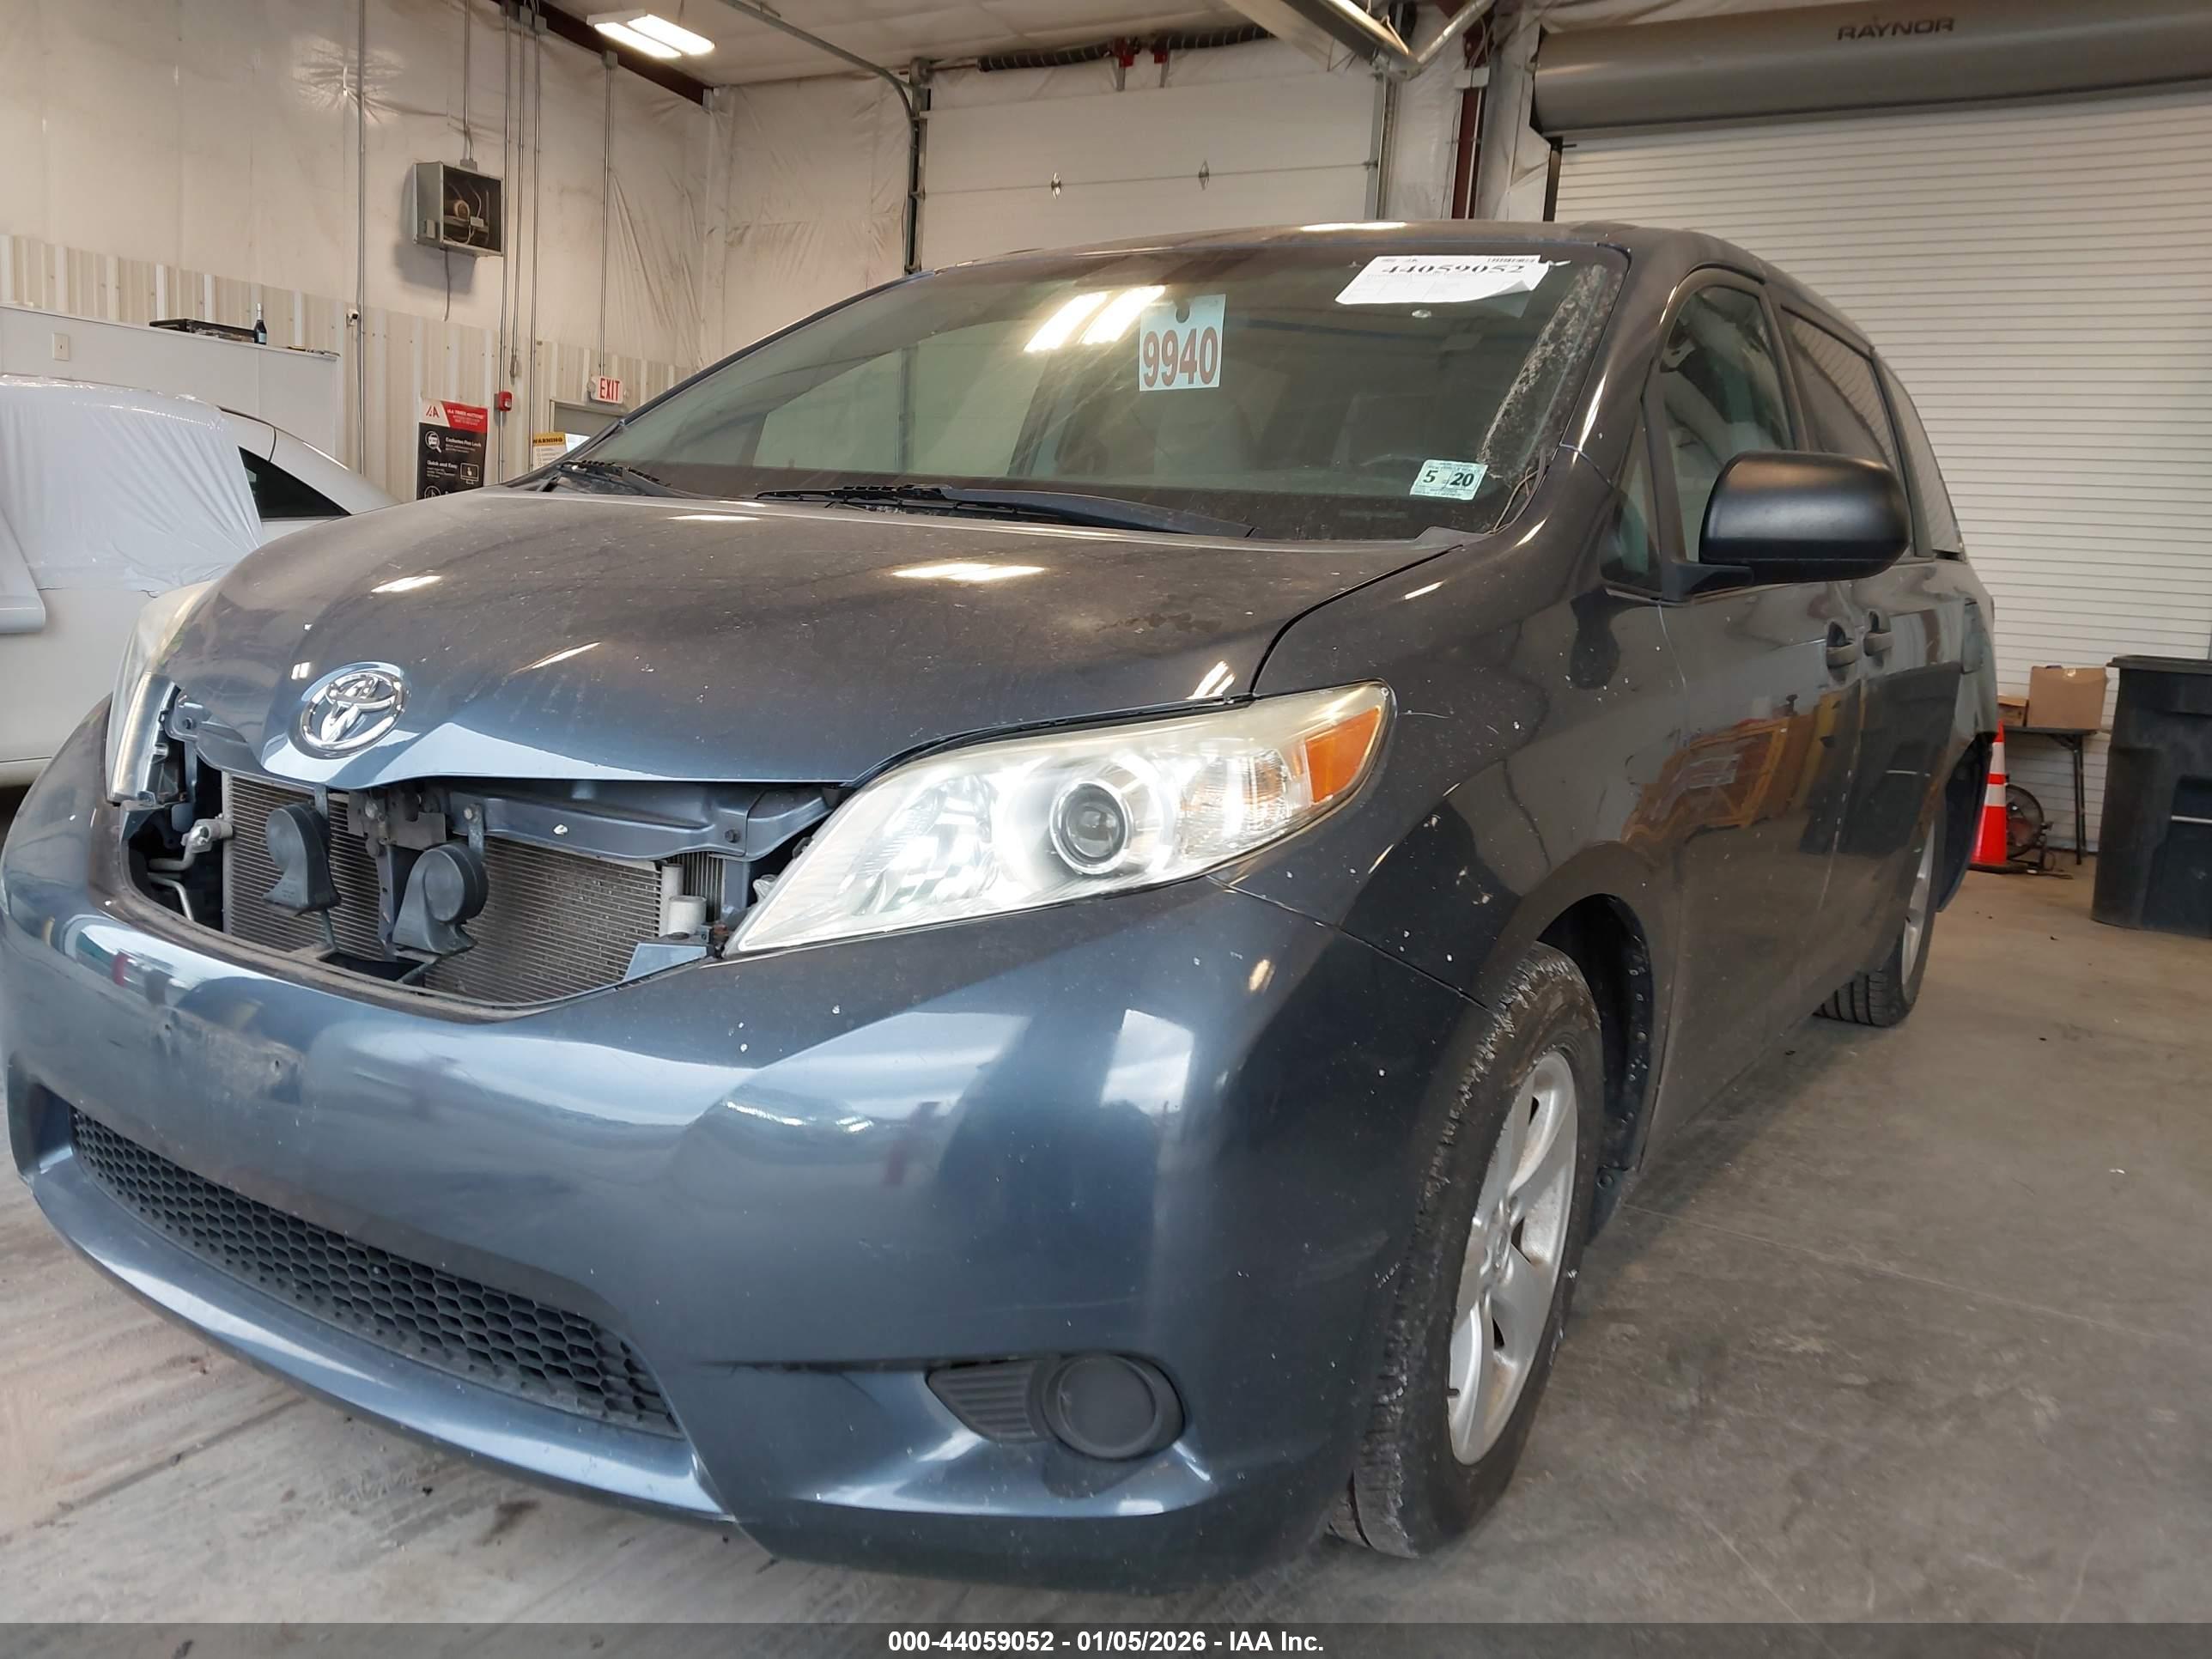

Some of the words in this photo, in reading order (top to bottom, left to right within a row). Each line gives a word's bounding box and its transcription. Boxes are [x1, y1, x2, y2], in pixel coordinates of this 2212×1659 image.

[1837, 16, 1954, 40] RAYNOR
[1381, 264, 1526, 274] 44059052
[1143, 326, 1218, 387] 9940
[600, 378, 620, 401] EXIT
[1423, 470, 1438, 483] 5
[1449, 472, 1475, 487] 20
